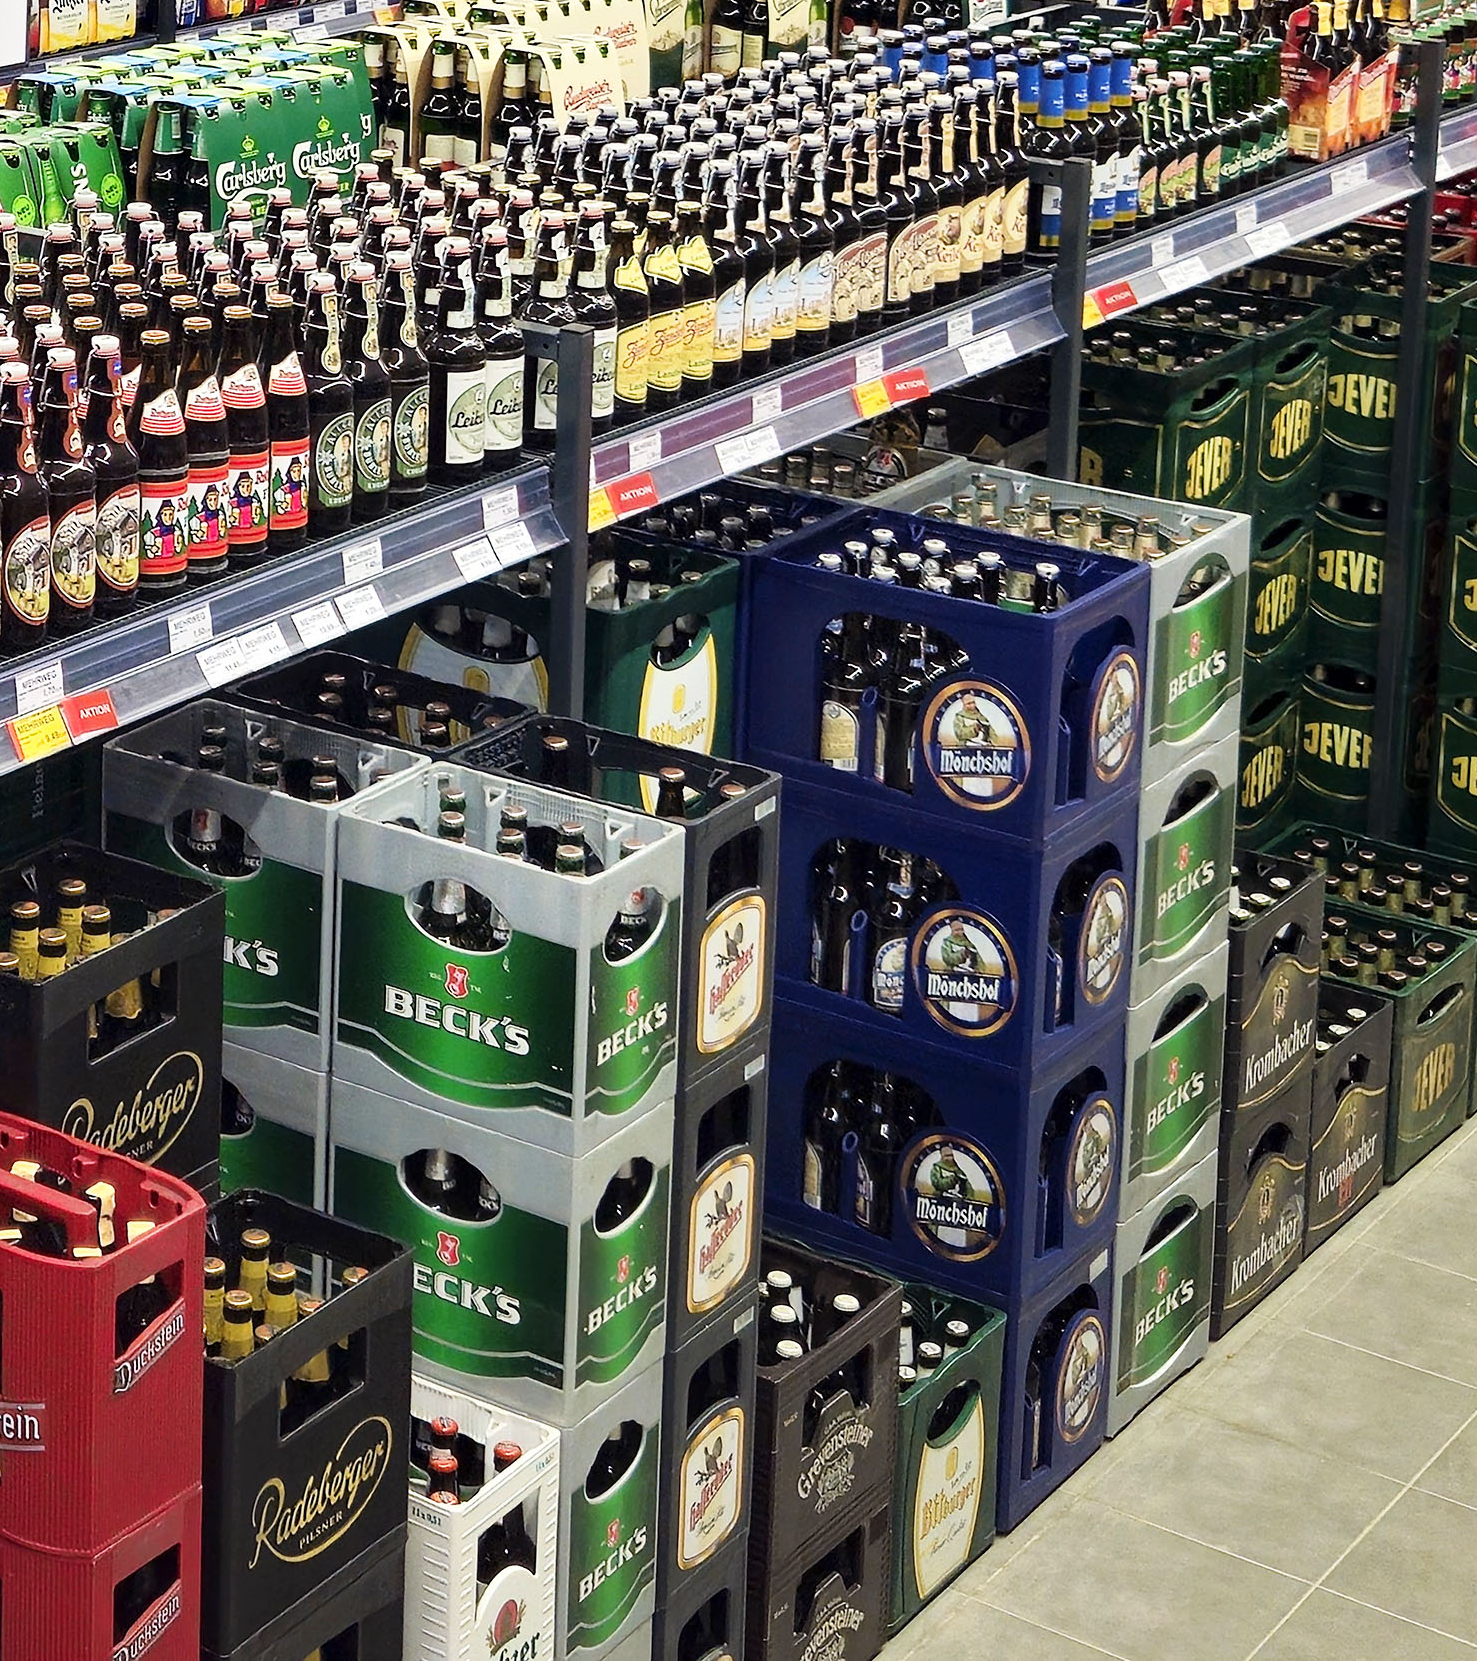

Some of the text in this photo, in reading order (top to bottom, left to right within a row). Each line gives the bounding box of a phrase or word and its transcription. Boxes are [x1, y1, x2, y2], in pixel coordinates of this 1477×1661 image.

[215, 153, 287, 201] Carlsberg
[292, 132, 361, 176] Carlsberg
[1105, 292, 1131, 306] AKTION
[896, 379, 926, 390] AKTION
[1270, 398, 1314, 460] JEVER
[619, 488, 653, 501] AKTION
[1185, 435, 1232, 499] JEVER
[1256, 572, 1297, 635] JEVER
[79, 702, 112, 717] AKTION
[940, 749, 1013, 775] Mönchshof
[383, 983, 530, 1055] BECK'S
[926, 976, 999, 1004] Mönchshof
[596, 1001, 669, 1066] BECK'S
[1246, 1017, 1314, 1093] Krombacher
[1147, 1071, 1205, 1134] BECK'S
[1317, 1130, 1377, 1202] Krombacher
[915, 1198, 989, 1229] Mönchshof
[1231, 1215, 1298, 1295] Krombacher
[413, 1264, 521, 1325] ECK'S
[587, 1266, 657, 1334] BECK'S
[1136, 1280, 1195, 1347] BECK'S
[114, 1311, 185, 1393] Duckstein
[797, 1425, 874, 1498] Grevensteiner
[252, 1435, 389, 1570] Radeberger
[298, 1509, 344, 1551] PILSNER
[579, 1526, 647, 1603] BECK'S
